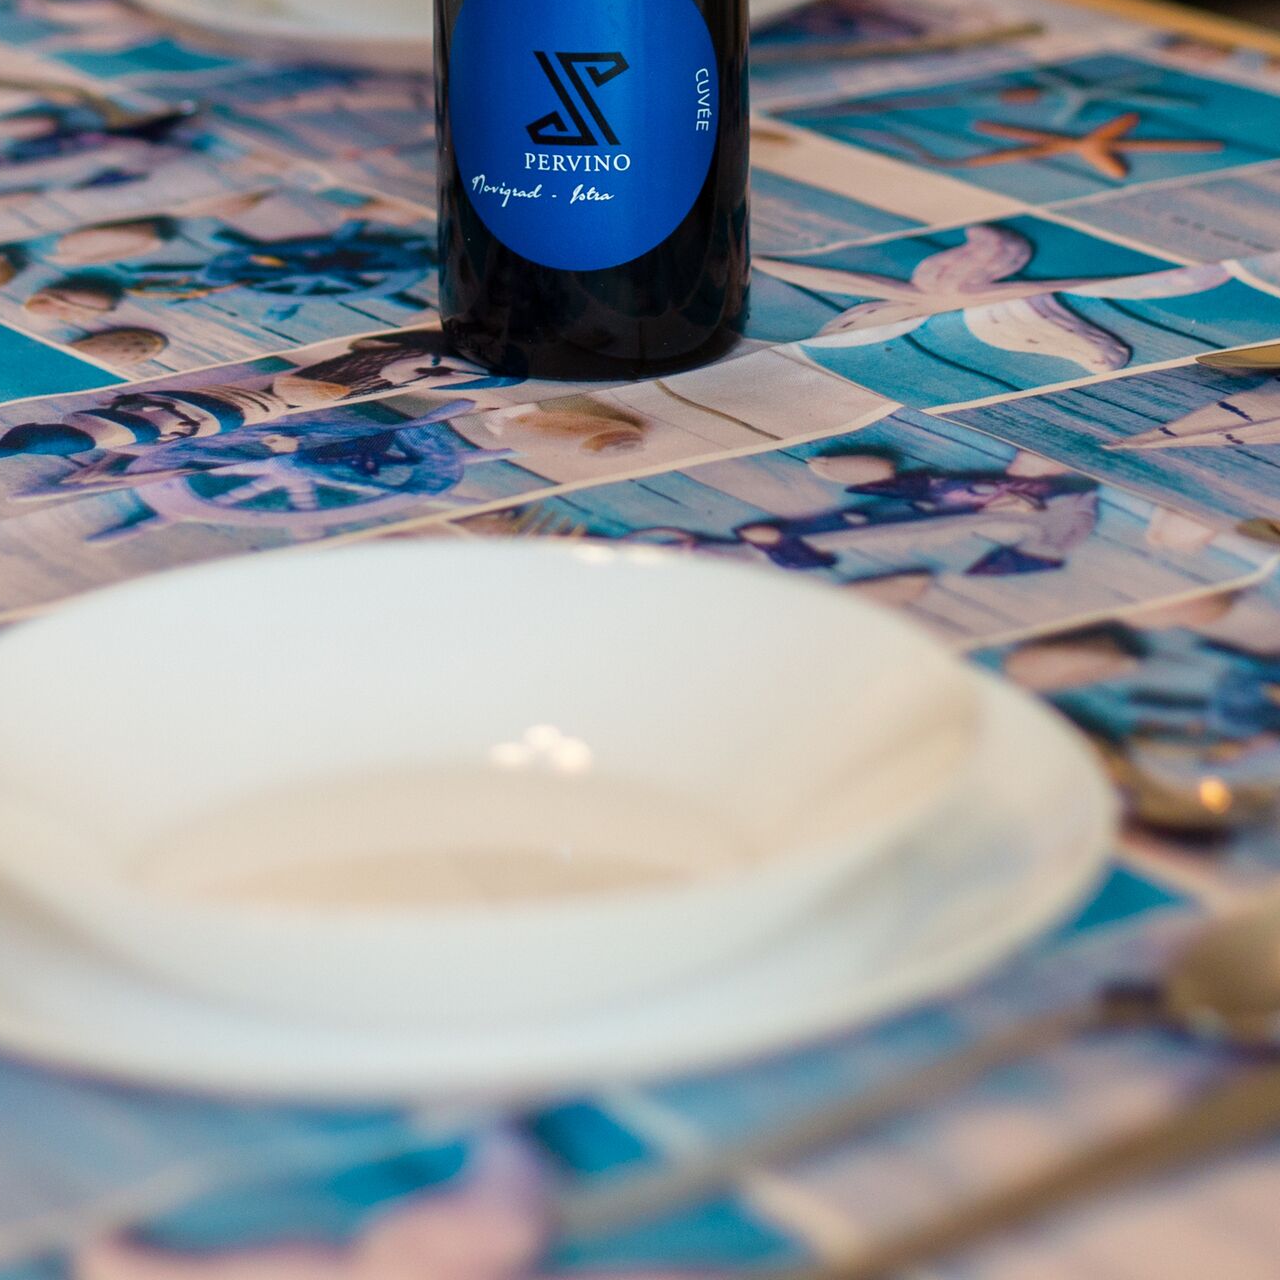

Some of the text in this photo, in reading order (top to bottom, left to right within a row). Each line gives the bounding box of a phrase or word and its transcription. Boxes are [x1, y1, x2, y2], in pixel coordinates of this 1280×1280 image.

[695, 68, 712, 131] CUVÉE
[524, 152, 631, 172] PERVINO
[472, 174, 543, 207] Novigrad
[569, 184, 616, 204] Istra
